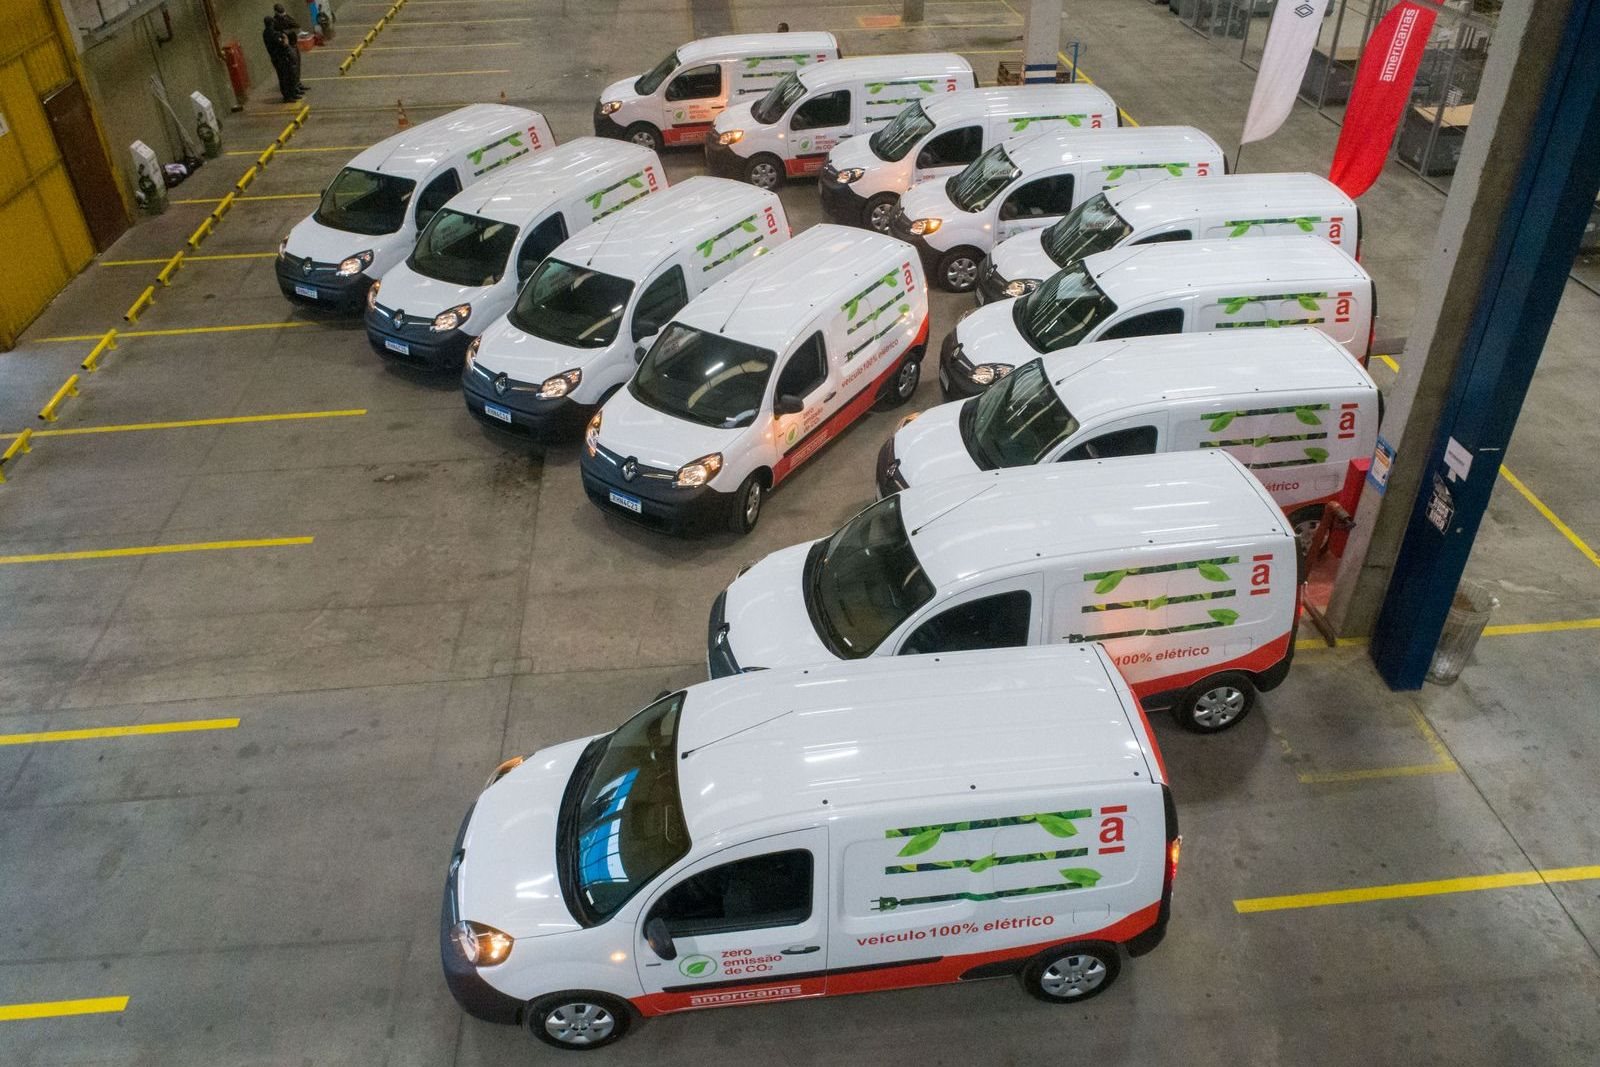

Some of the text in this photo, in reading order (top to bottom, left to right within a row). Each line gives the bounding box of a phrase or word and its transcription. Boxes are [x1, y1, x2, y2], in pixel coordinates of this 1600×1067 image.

[1383, 9, 1416, 82] americanas
[1264, 480, 1299, 492] étrico
[1114, 646, 1210, 666] 100% elétrico
[1100, 817, 1124, 844] a
[857, 915, 1054, 946] veículo 100% elétrico
[721, 948, 752, 958] zero
[723, 954, 782, 967] emissão
[724, 967, 742, 976] de
[691, 986, 801, 1005] americanas
